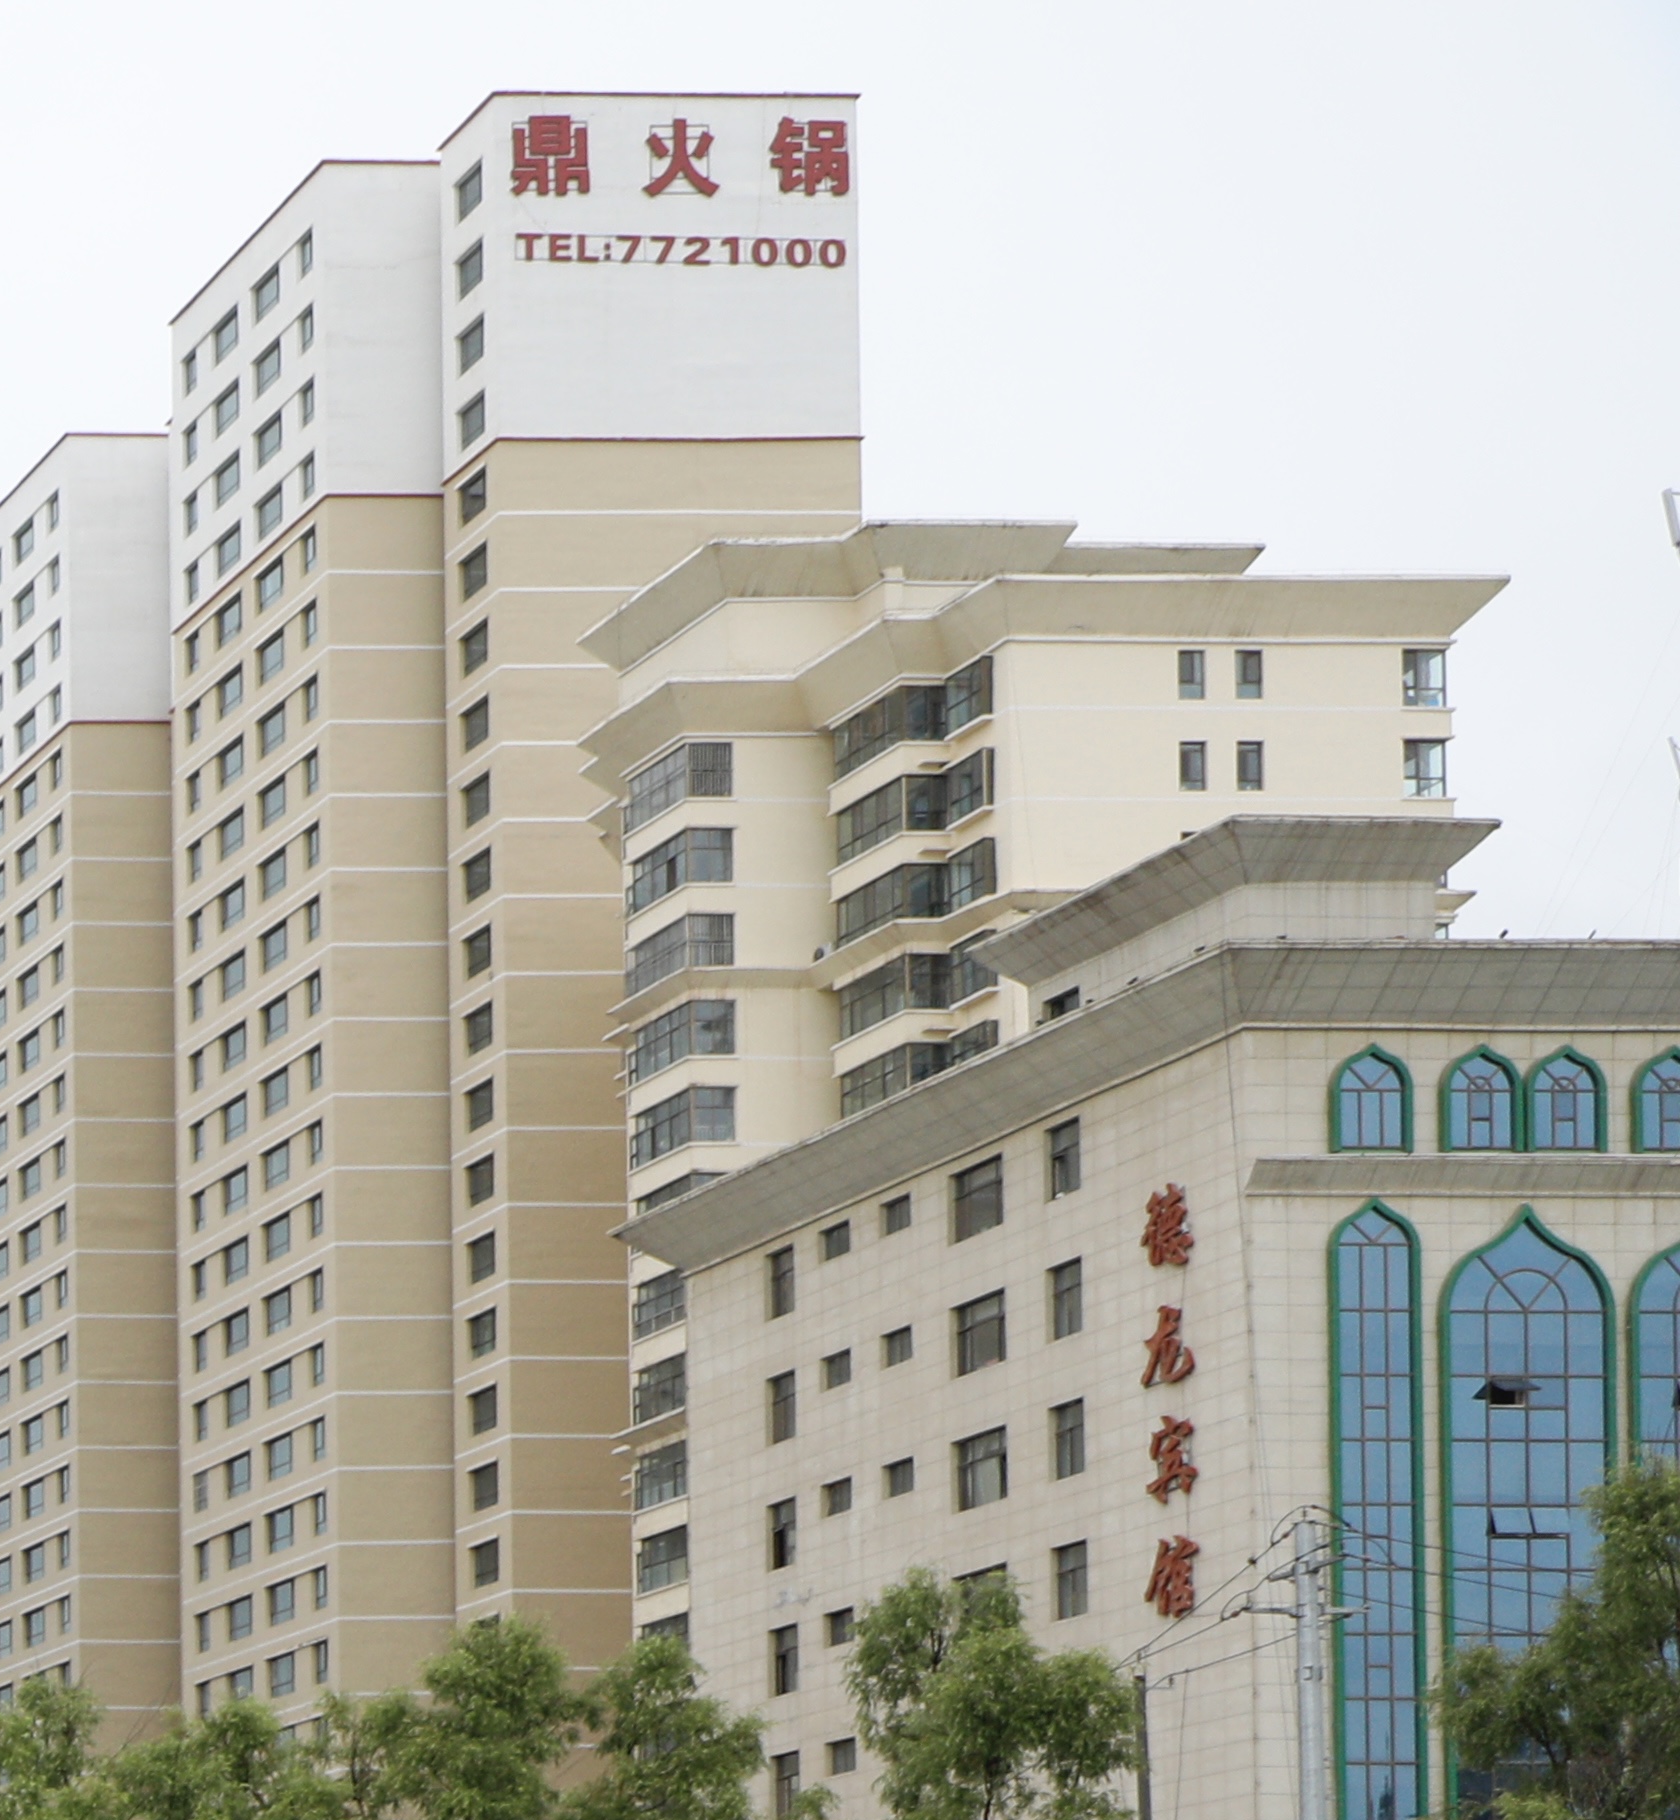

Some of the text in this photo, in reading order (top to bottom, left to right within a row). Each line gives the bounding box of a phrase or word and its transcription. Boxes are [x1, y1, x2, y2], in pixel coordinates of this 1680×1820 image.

[510, 114, 850, 198] 鼎火锅
[516, 232, 846, 268] TEL:7721000
[1140, 1182, 1200, 1618] 德龙宾馆
